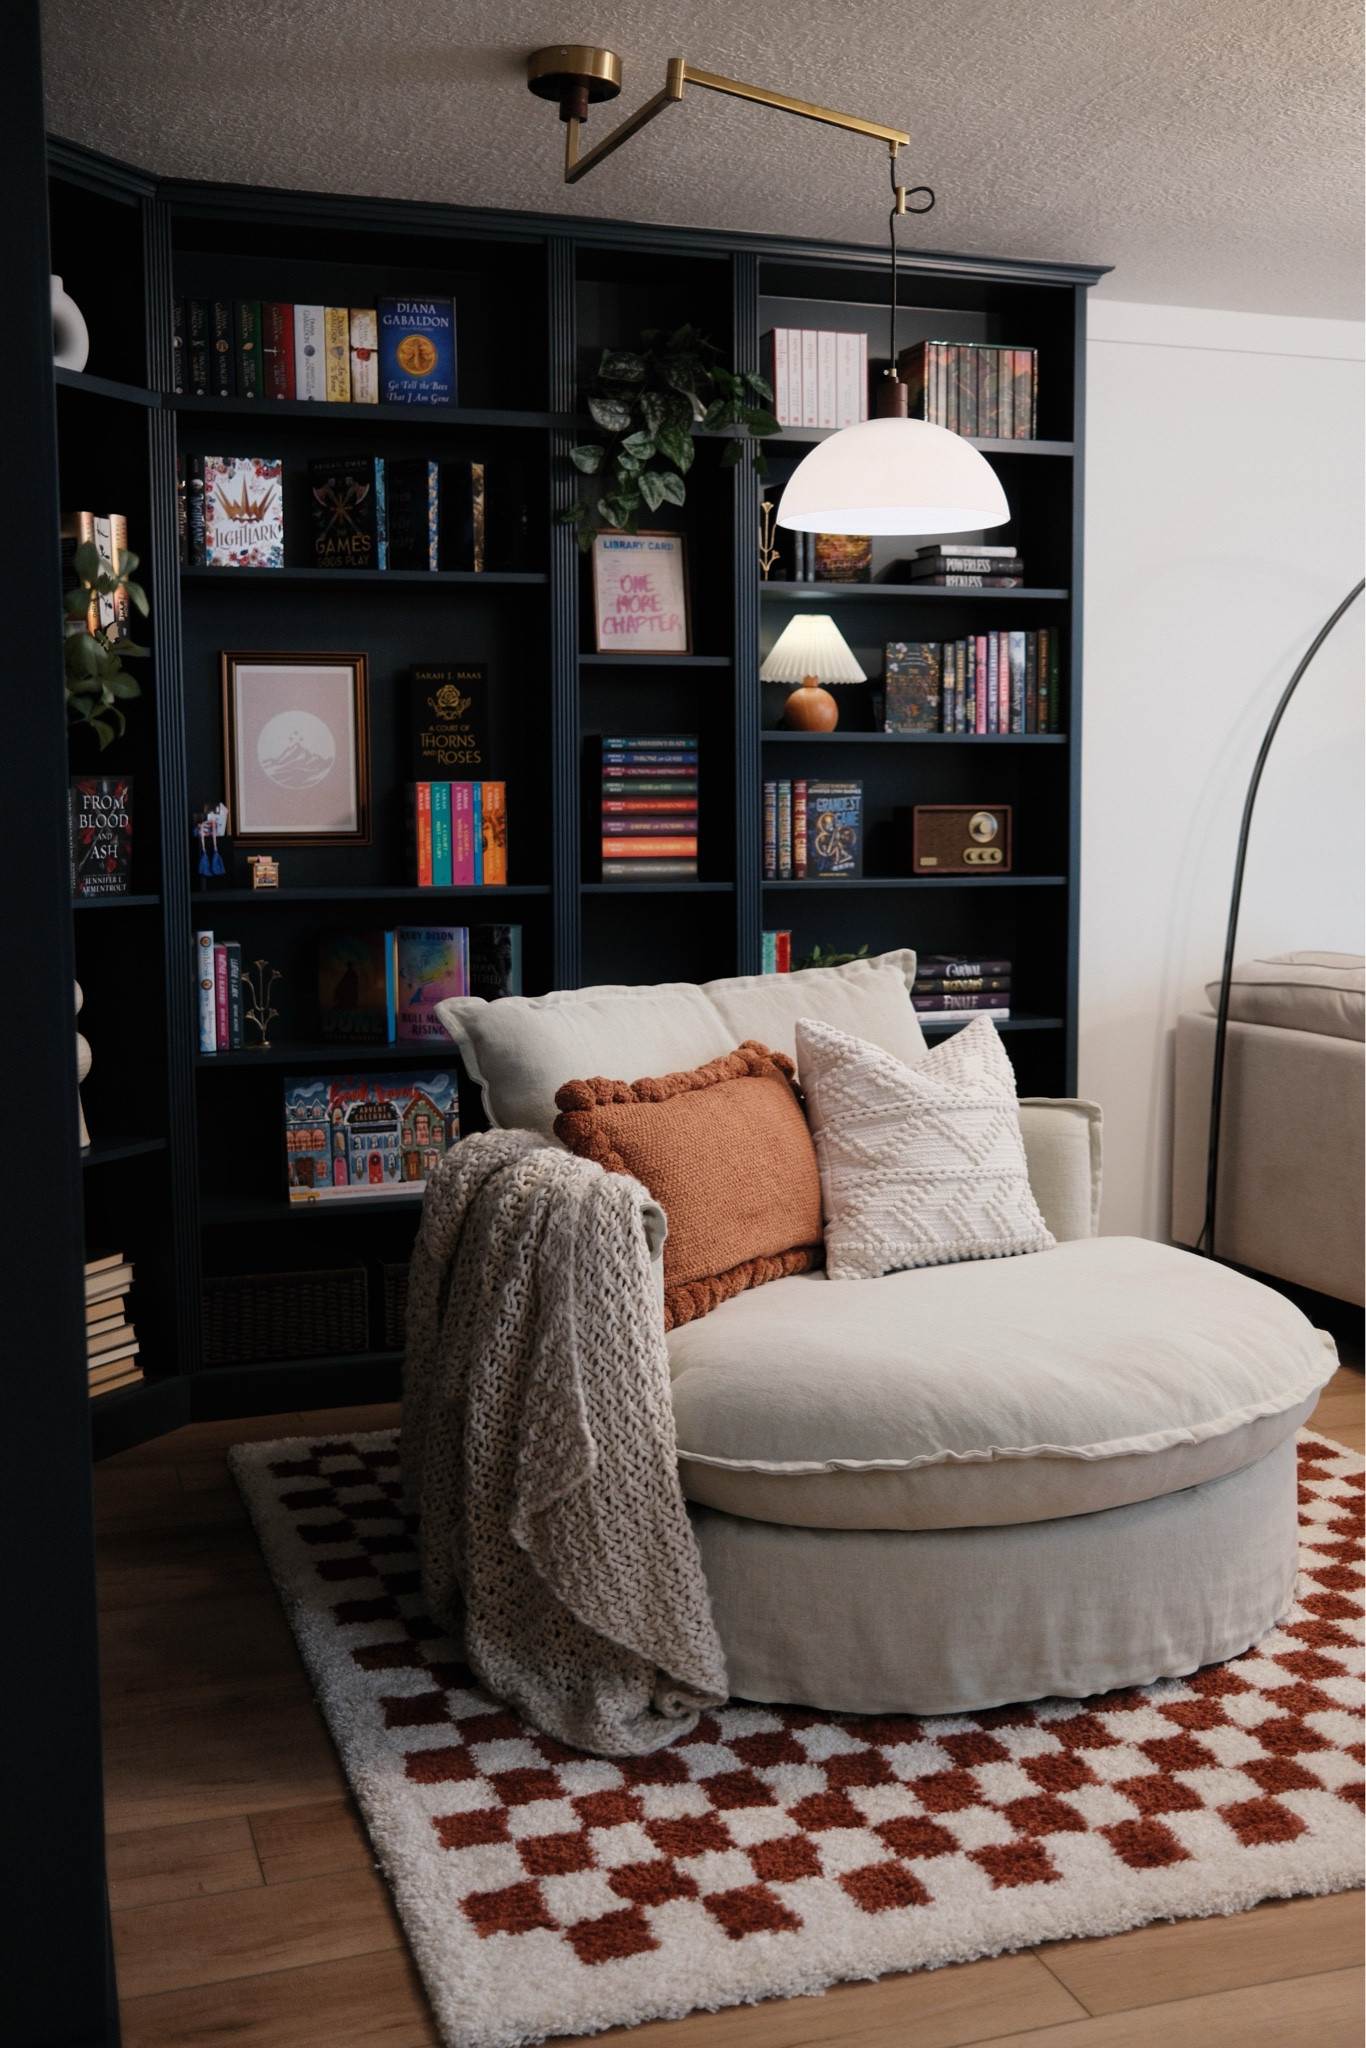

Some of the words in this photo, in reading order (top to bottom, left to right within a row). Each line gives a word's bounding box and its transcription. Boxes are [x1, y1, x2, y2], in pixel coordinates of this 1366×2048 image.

[397, 302, 437, 315] DIANA
[382, 314, 450, 328] GABALDON
[388, 380, 400, 392] Go
[401, 380, 417, 390] Tell
[419, 380, 430, 391] the
[431, 381, 449, 391] Bees
[387, 392, 406, 402] That
[407, 392, 412, 404] I
[415, 393, 429, 403] Am
[430, 393, 450, 405] Gone
[345, 459, 368, 469] OWEN
[213, 523, 278, 551] LIGHTLARK
[315, 534, 372, 558] GAMES
[603, 540, 644, 551] LIBRARY
[648, 542, 674, 551] CARD
[316, 556, 342, 568] GODS
[345, 554, 370, 566] PLAY
[945, 558, 992, 573] POWERLESS
[619, 573, 655, 594] ONE
[945, 575, 983, 588] RECKLESS
[615, 593, 664, 615] MORE
[601, 613, 683, 636] CHAPTER
[415, 671, 445, 681] SARAH
[456, 671, 482, 681] MAAS
[435, 724, 459, 732] COURT
[460, 724, 471, 732] OF
[419, 731, 476, 749] THORNS
[436, 749, 482, 766] ROSES
[82, 794, 125, 811] FROM
[794, 799, 807, 814] THE
[816, 796, 862, 812] GRANDEST
[79, 813, 130, 830] BLOOD
[794, 814, 807, 835] FINAL
[835, 811, 860, 827] GAME
[98, 832, 113, 841] AND
[90, 844, 119, 860] ASH
[794, 838, 807, 865] GAMBIT
[81, 883, 127, 895] ARMENTROUT
[84, 876, 115, 888] JENNIFER
[399, 931, 423, 941] RUBY
[425, 931, 454, 941] DIXON
[945, 963, 984, 978] CARAVAL
[943, 994, 980, 1010] FINALE
[402, 1012, 423, 1024] BULL
[411, 1024, 445, 1036] RISING
[329, 1080, 372, 1105] Book
[353, 1112, 394, 1122] CALENDAR
[358, 1106, 389, 1114] ADVENT
